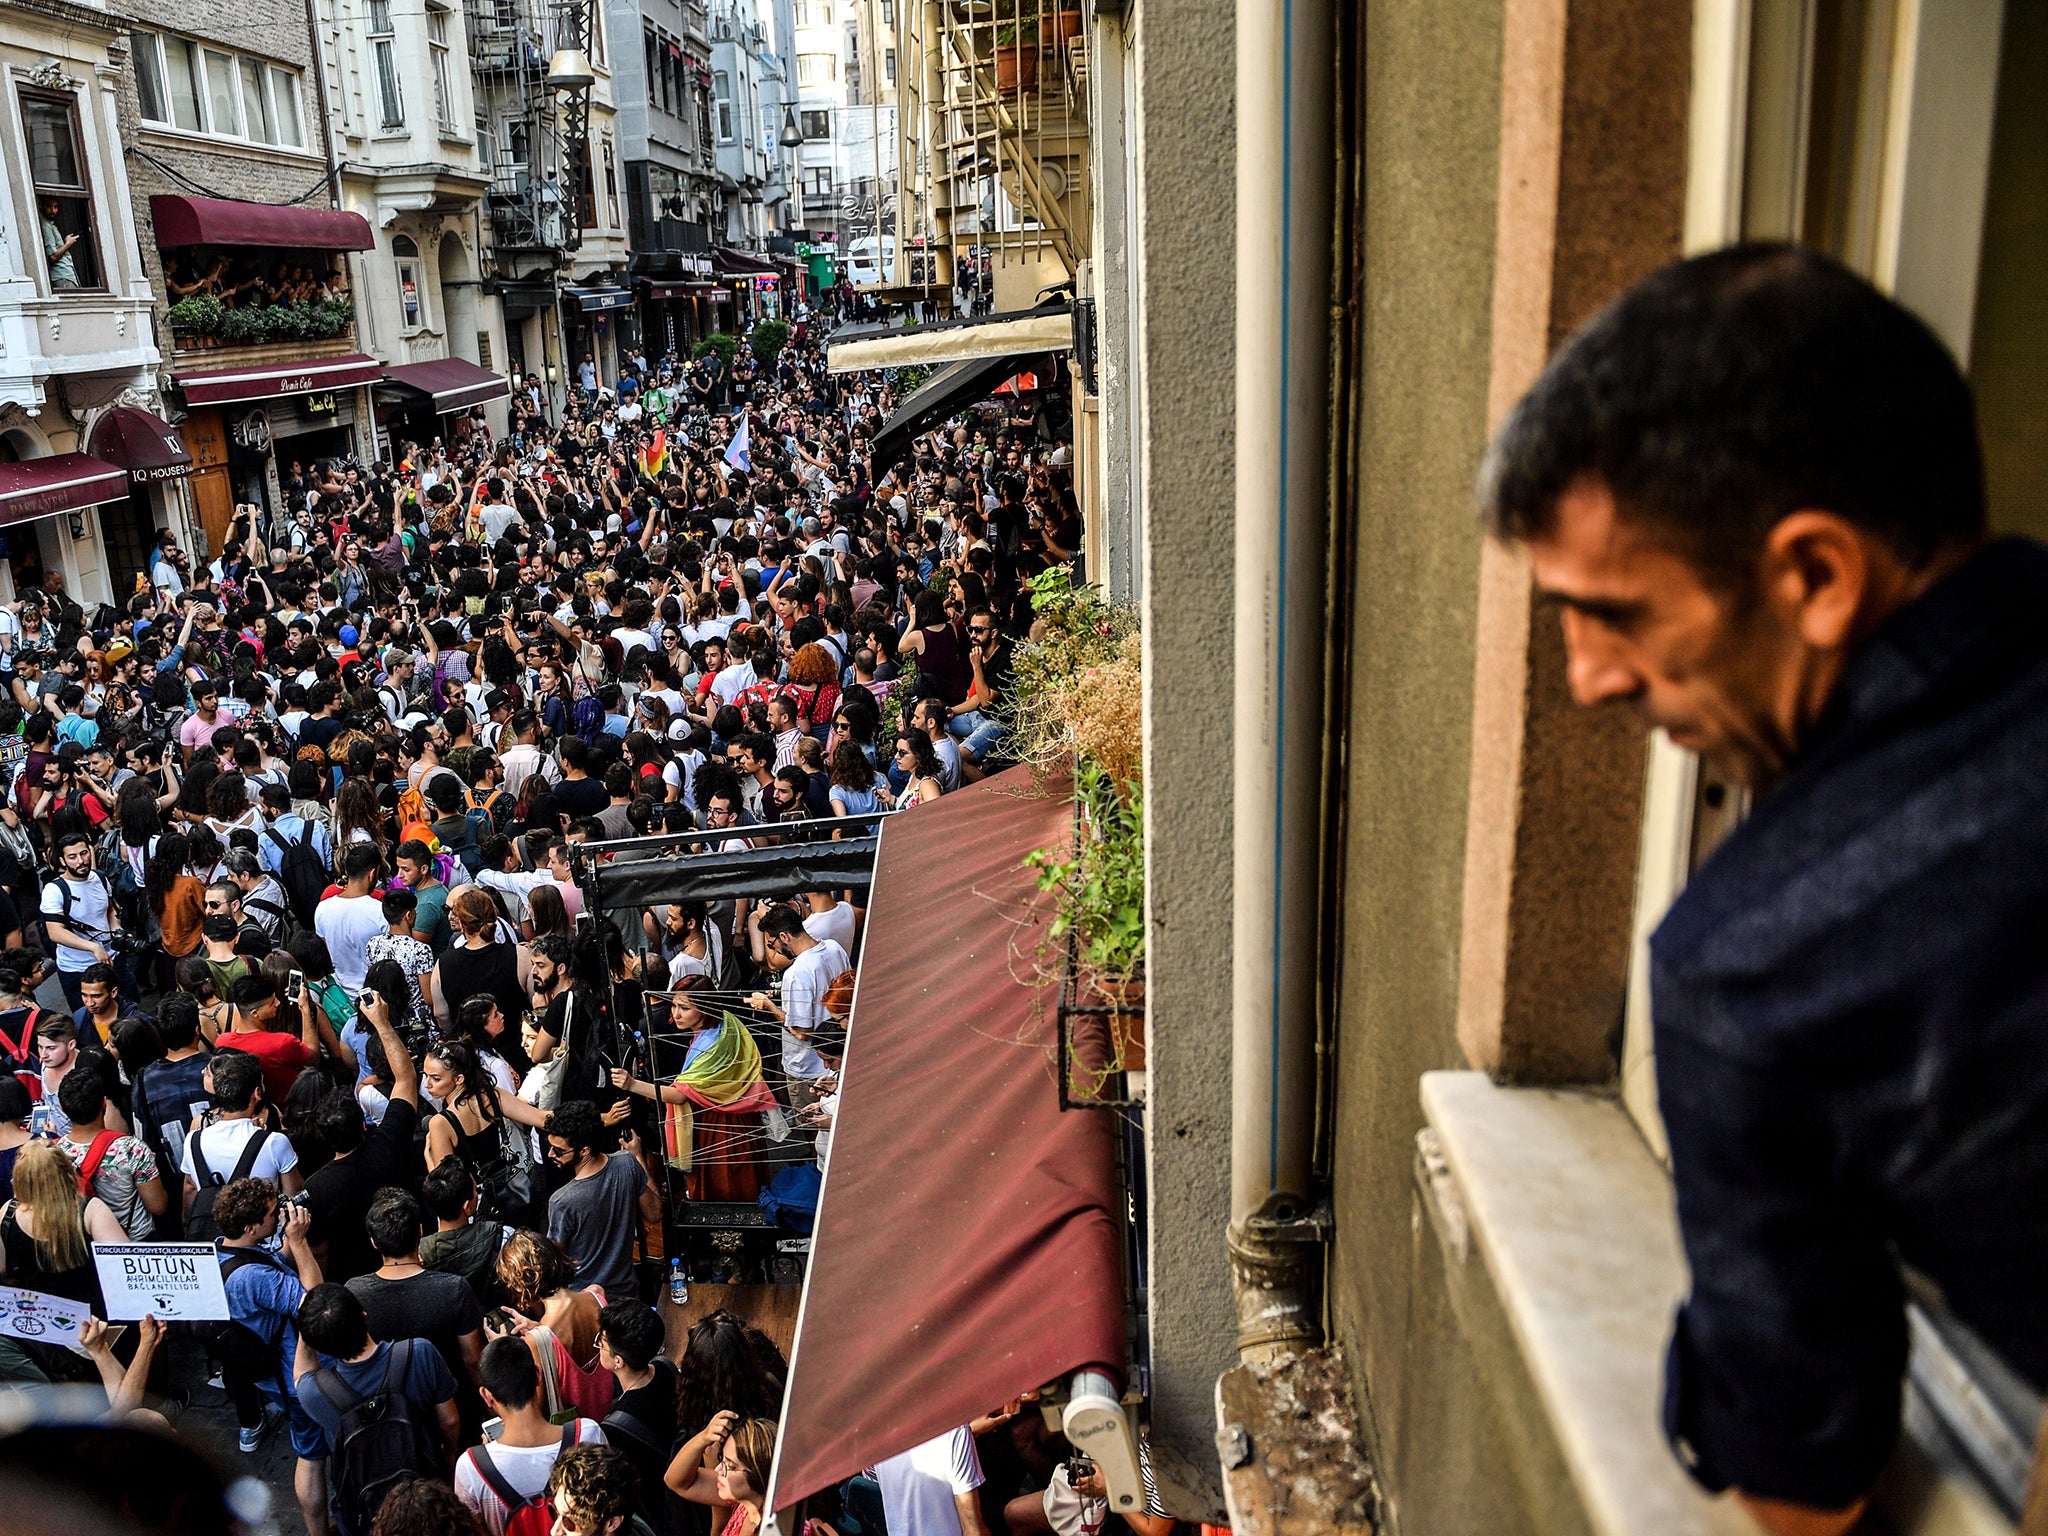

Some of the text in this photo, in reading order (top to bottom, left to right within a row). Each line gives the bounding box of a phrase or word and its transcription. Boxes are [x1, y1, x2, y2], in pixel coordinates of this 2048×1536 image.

[132, 469, 148, 482] IQ
[149, 465, 186, 479] HOUSES
[123, 1256, 196, 1275] BÜTÜN
